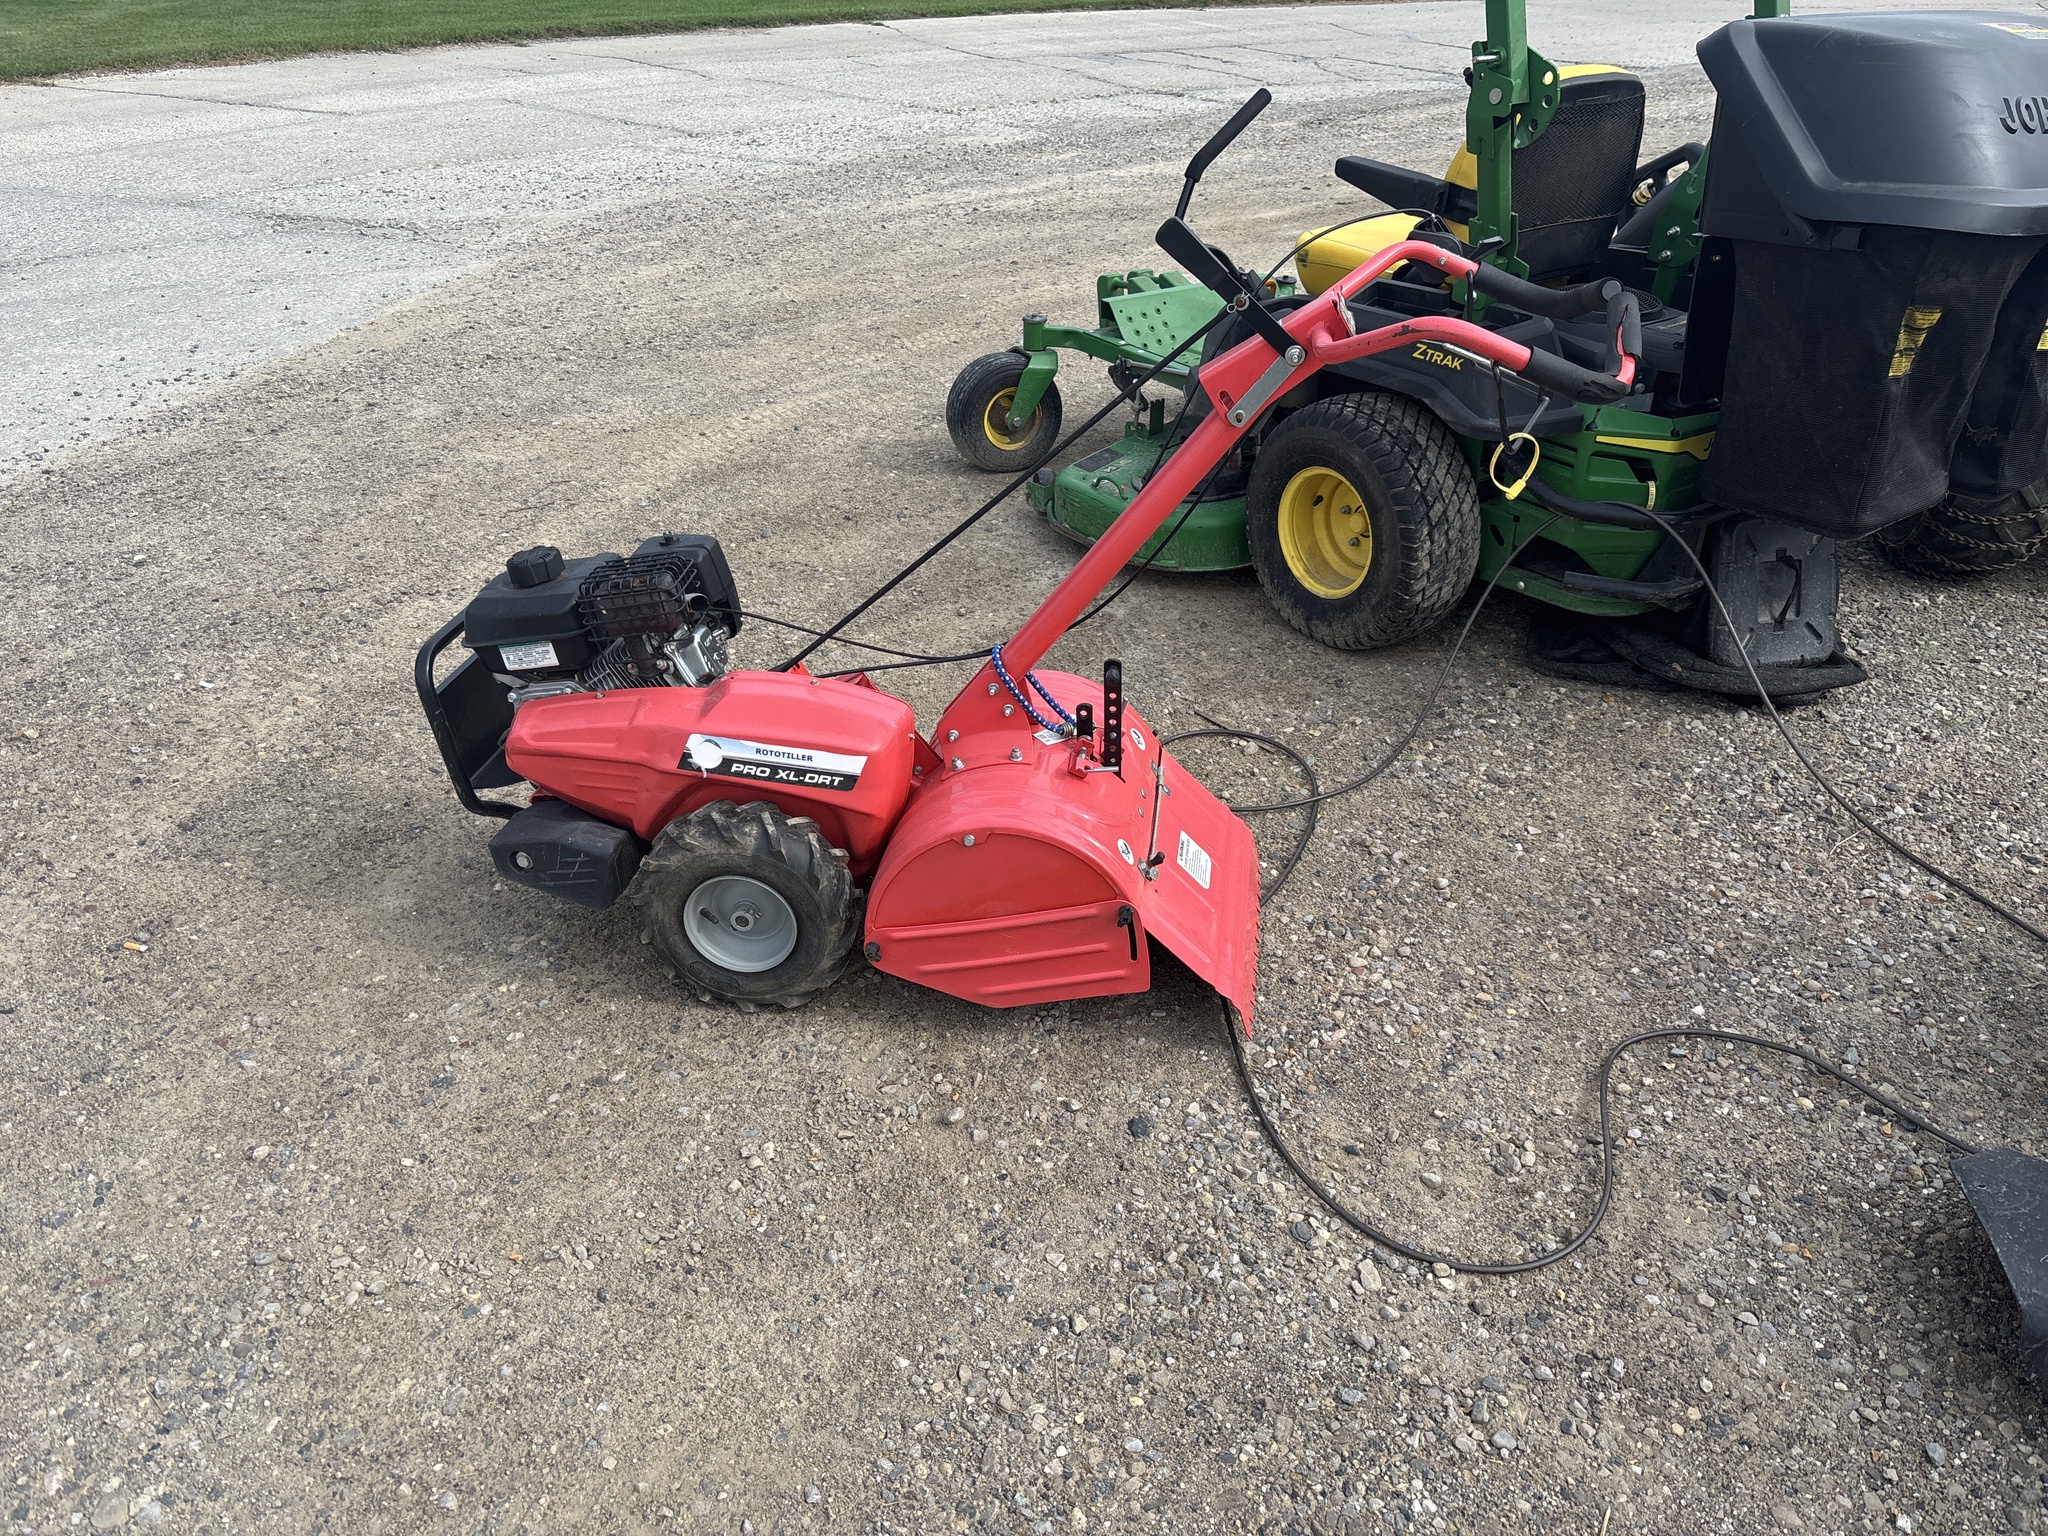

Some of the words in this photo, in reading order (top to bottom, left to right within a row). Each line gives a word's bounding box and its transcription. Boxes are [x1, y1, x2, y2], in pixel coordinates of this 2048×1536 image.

[1412, 343, 1464, 370] ZTRAK
[755, 748, 813, 762] ROTOTILLER
[731, 763, 771, 777] PRO
[775, 770, 844, 786] XL-DRT
